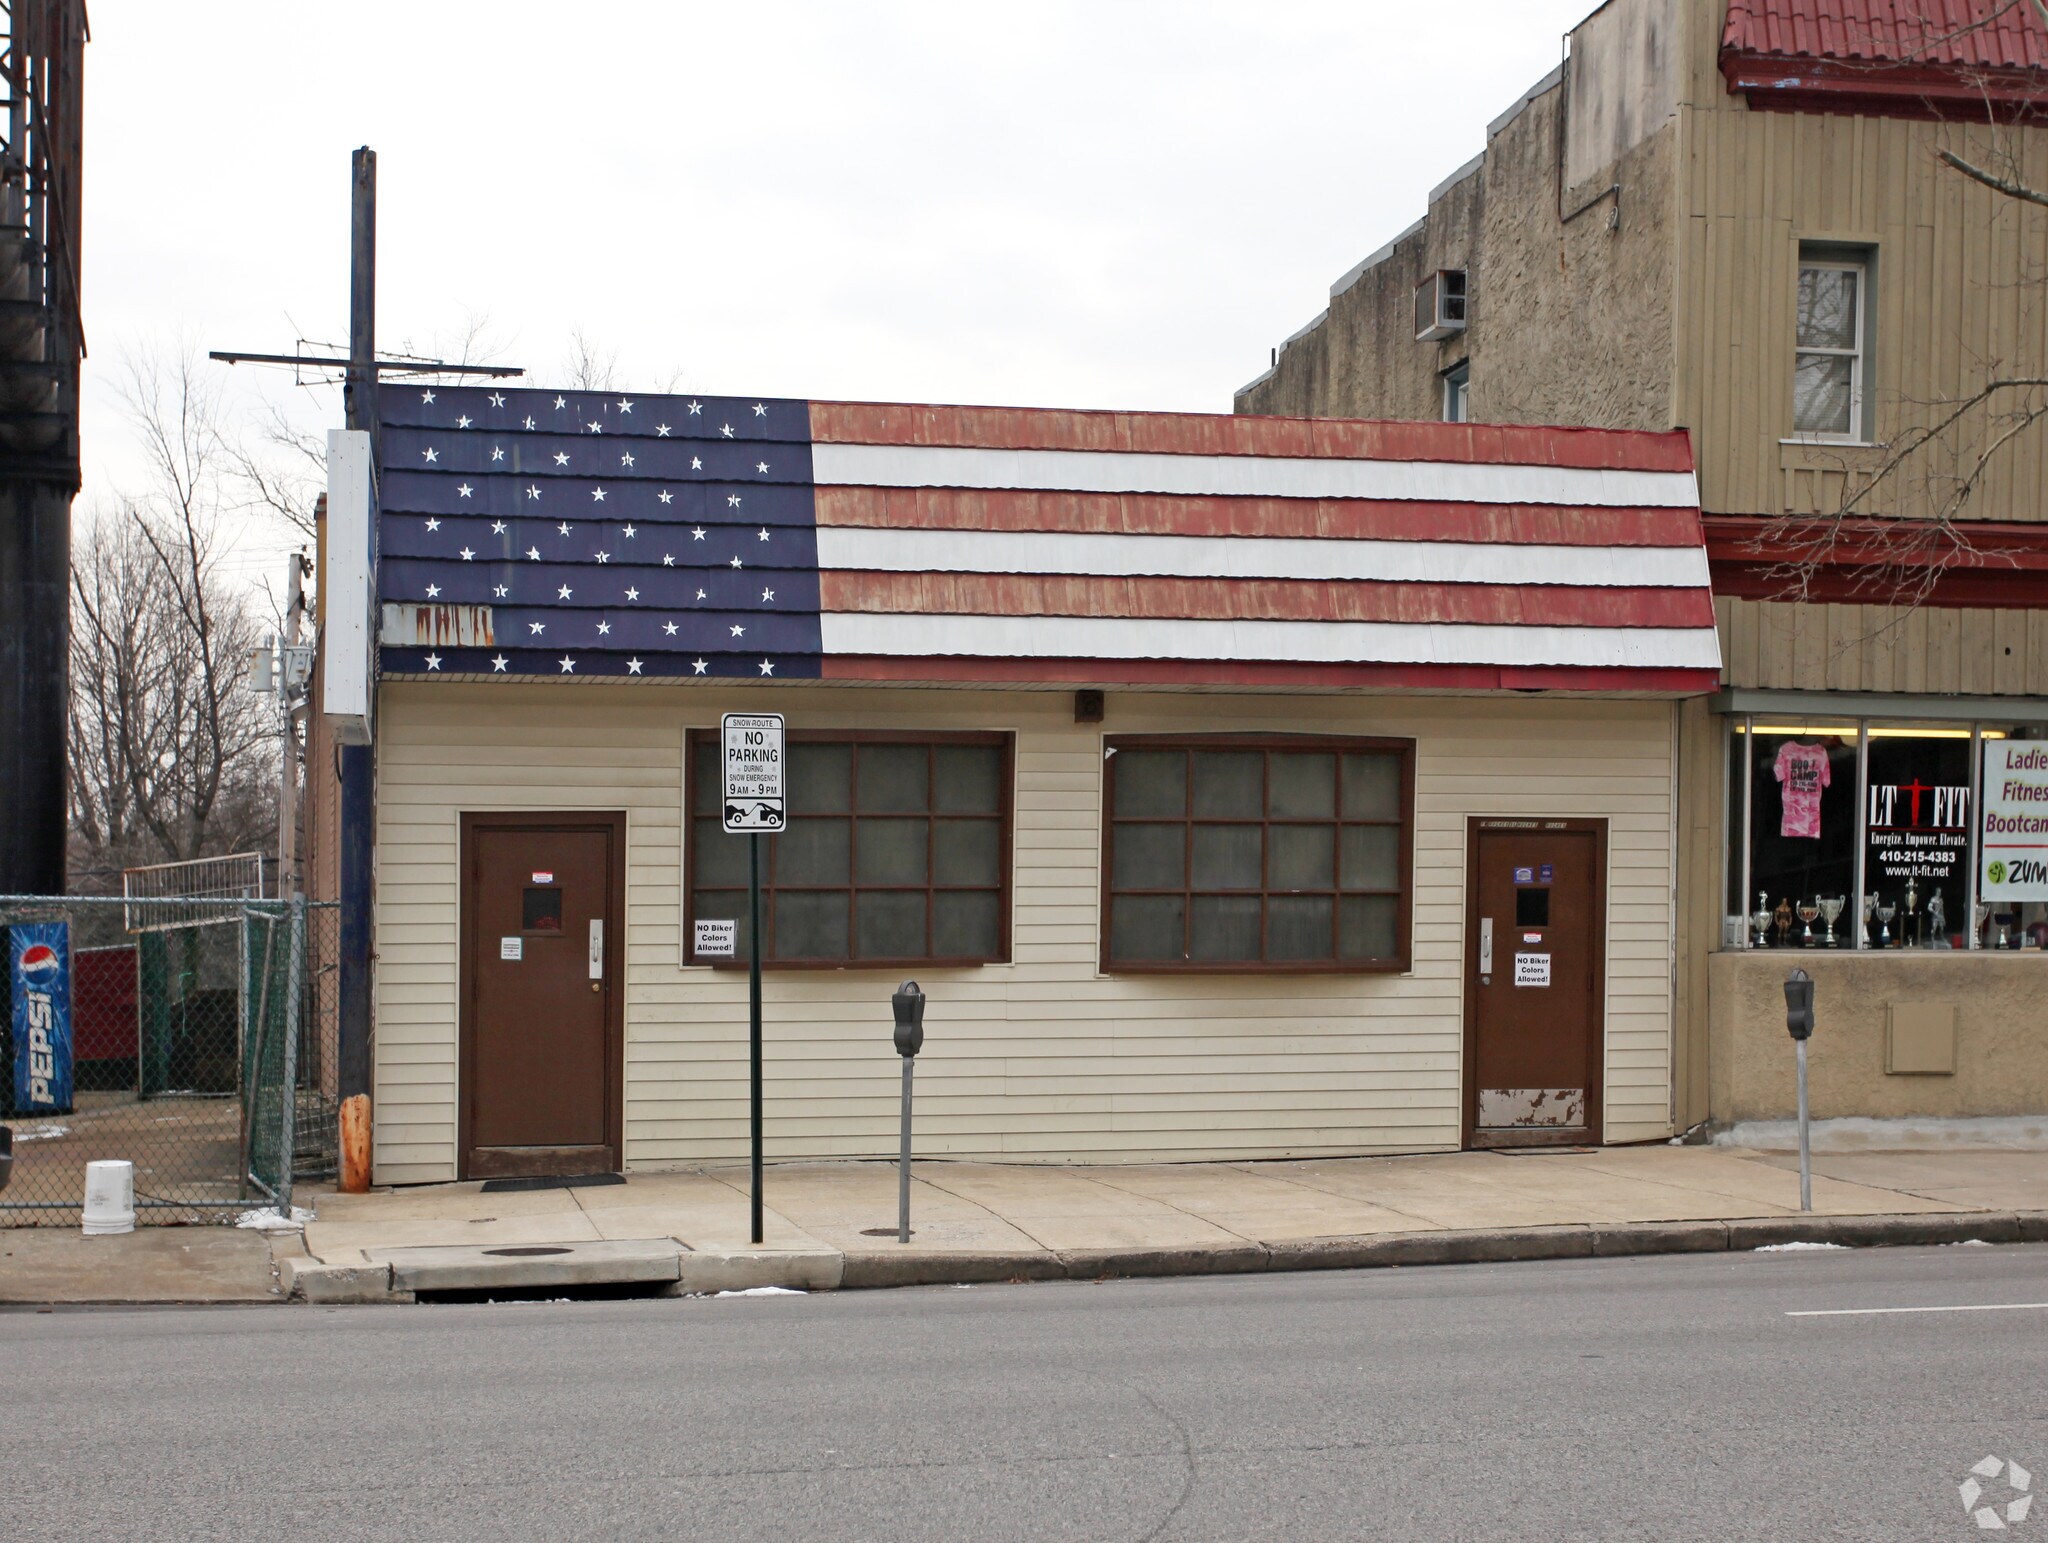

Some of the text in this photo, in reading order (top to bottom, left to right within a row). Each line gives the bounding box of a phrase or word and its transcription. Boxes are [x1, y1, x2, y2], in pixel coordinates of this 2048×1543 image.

[733, 719, 751, 727] SNOW
[745, 731, 764, 745] NO
[729, 748, 778, 762] PARKING
[746, 774, 777, 782] EMERGENCY
[1869, 785, 1970, 828] LT FIT
[1871, 832, 1967, 848] Energize. Empower. Elevate.
[1879, 850, 1956, 863] 410-215-4383
[1885, 865, 1949, 877] www.lt-fit.net
[2008, 859, 2048, 885] ZUM
[28, 991, 54, 1104] PEPSI
